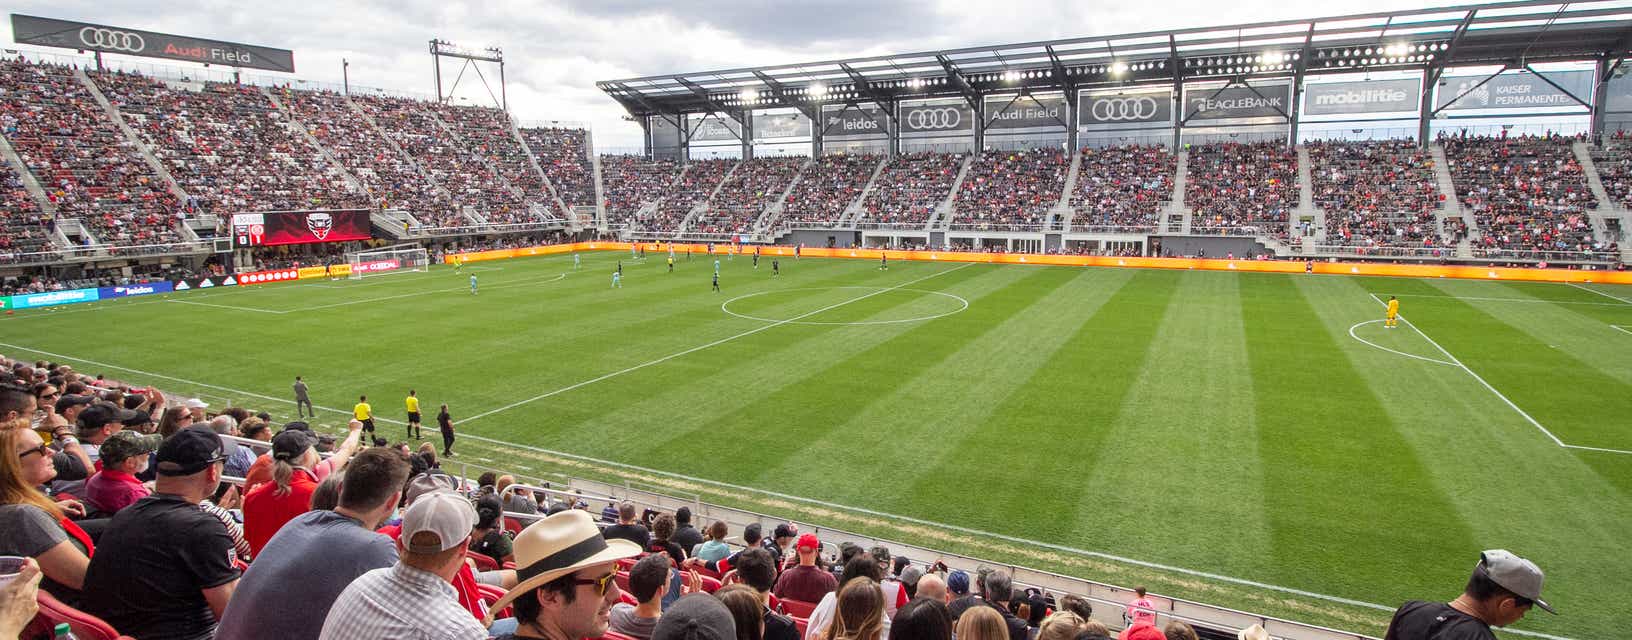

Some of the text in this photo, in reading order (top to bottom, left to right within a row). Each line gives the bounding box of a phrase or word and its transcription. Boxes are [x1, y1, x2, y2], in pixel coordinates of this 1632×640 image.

[164, 43, 250, 64] Audi Field
[1315, 89, 1405, 104] mobilitie
[1495, 84, 1531, 96] KAISER
[1495, 95, 1565, 106] PERMANENTE
[992, 107, 1058, 121] Audi Field
[843, 117, 878, 130] leidos
